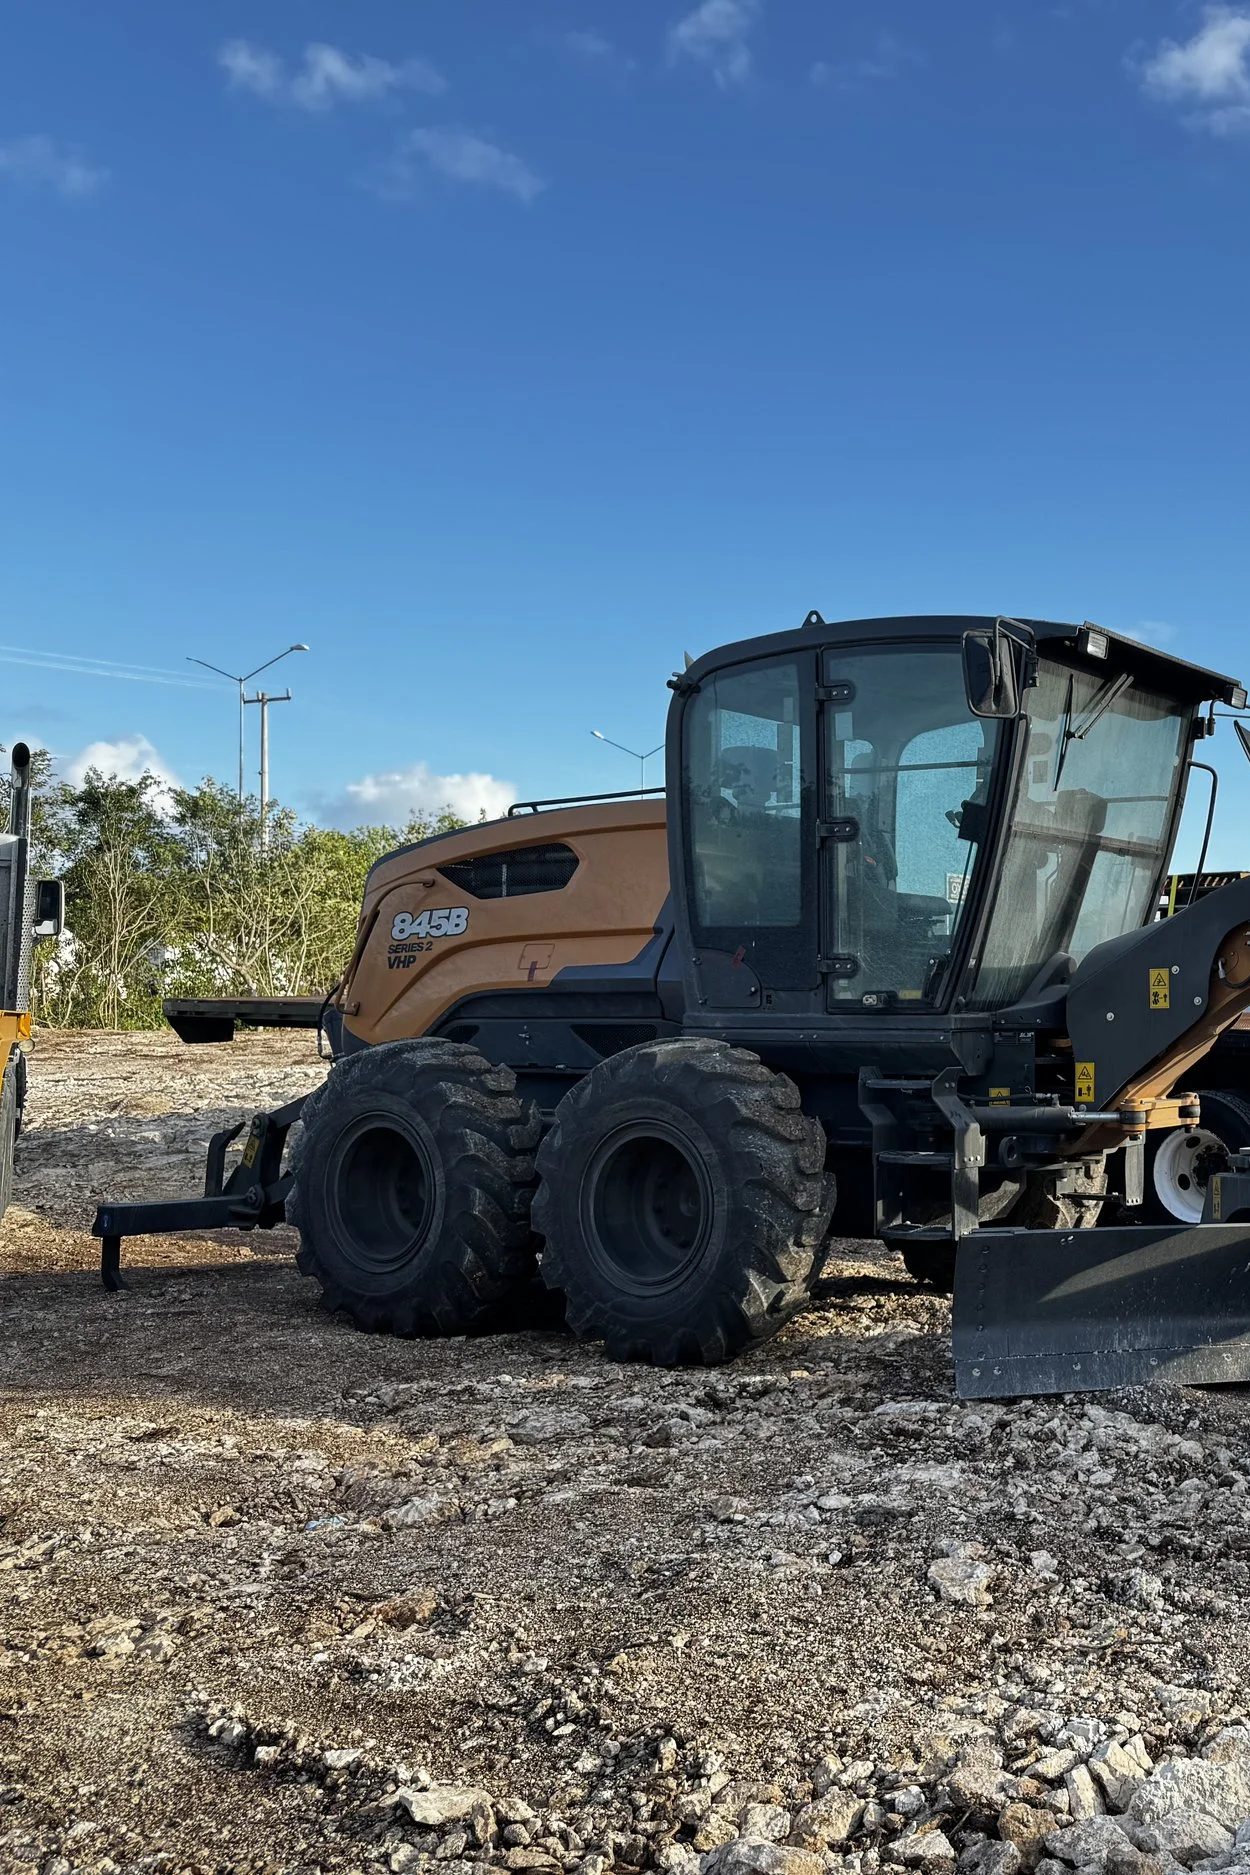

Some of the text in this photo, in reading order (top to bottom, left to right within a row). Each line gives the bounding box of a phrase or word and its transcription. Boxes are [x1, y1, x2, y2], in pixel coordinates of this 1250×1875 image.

[391, 906, 470, 941] 845B
[387, 941, 433, 954] SERIES 2
[387, 955, 417, 969] VHP
